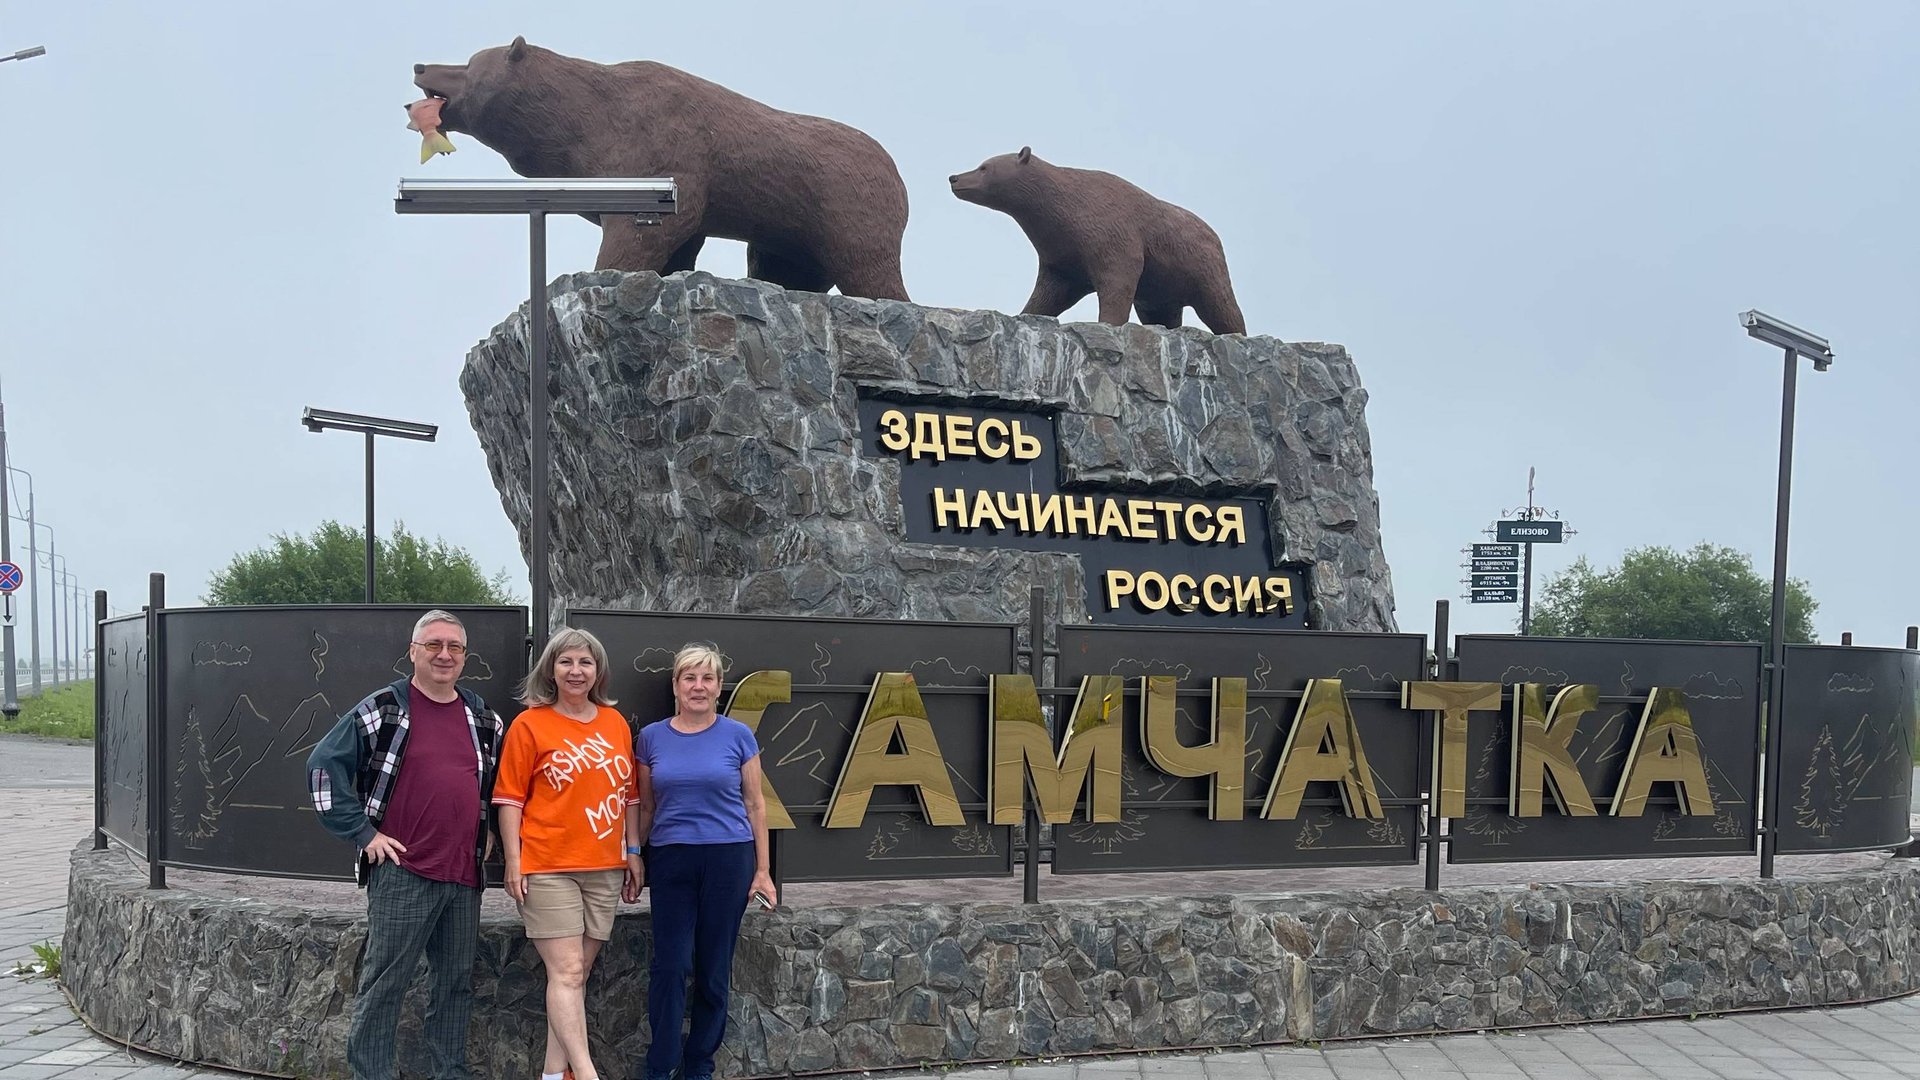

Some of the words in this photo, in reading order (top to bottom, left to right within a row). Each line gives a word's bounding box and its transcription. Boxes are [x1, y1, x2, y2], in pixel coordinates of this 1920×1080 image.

[880, 410, 1042, 461] ЗДЕСЬ
[934, 487, 1246, 544] НАЧИНАЕТСЯ
[1510, 528, 1549, 536] ЕЛИЗОВО
[1105, 569, 1294, 616] РОССИЯ
[595, 754, 632, 787] TO
